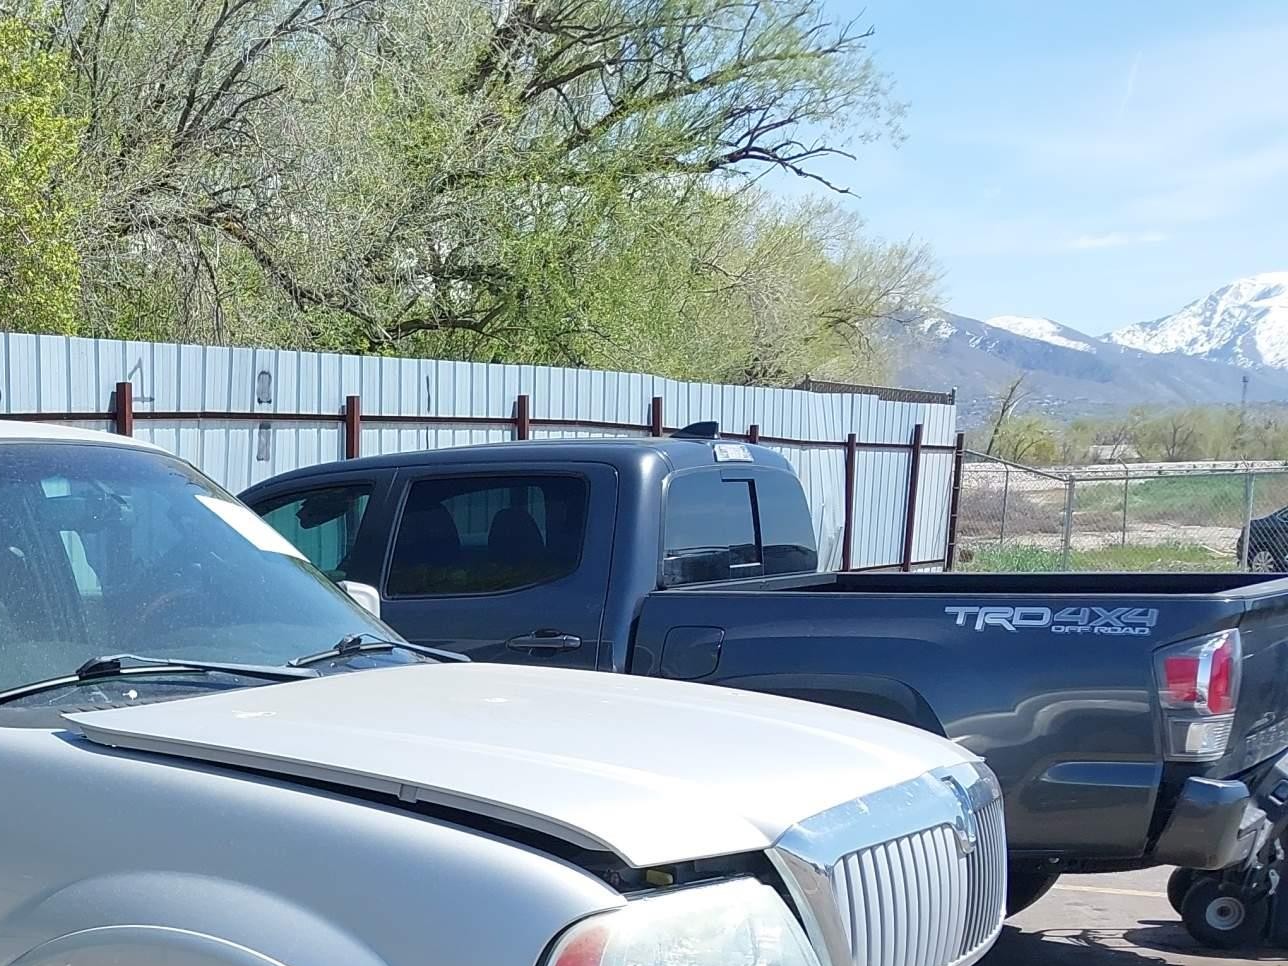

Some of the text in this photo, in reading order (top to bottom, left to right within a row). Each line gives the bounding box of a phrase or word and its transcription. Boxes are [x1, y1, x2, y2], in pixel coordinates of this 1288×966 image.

[944, 606, 1053, 633] TRD
[1051, 625, 1151, 636] OFF ROAD
